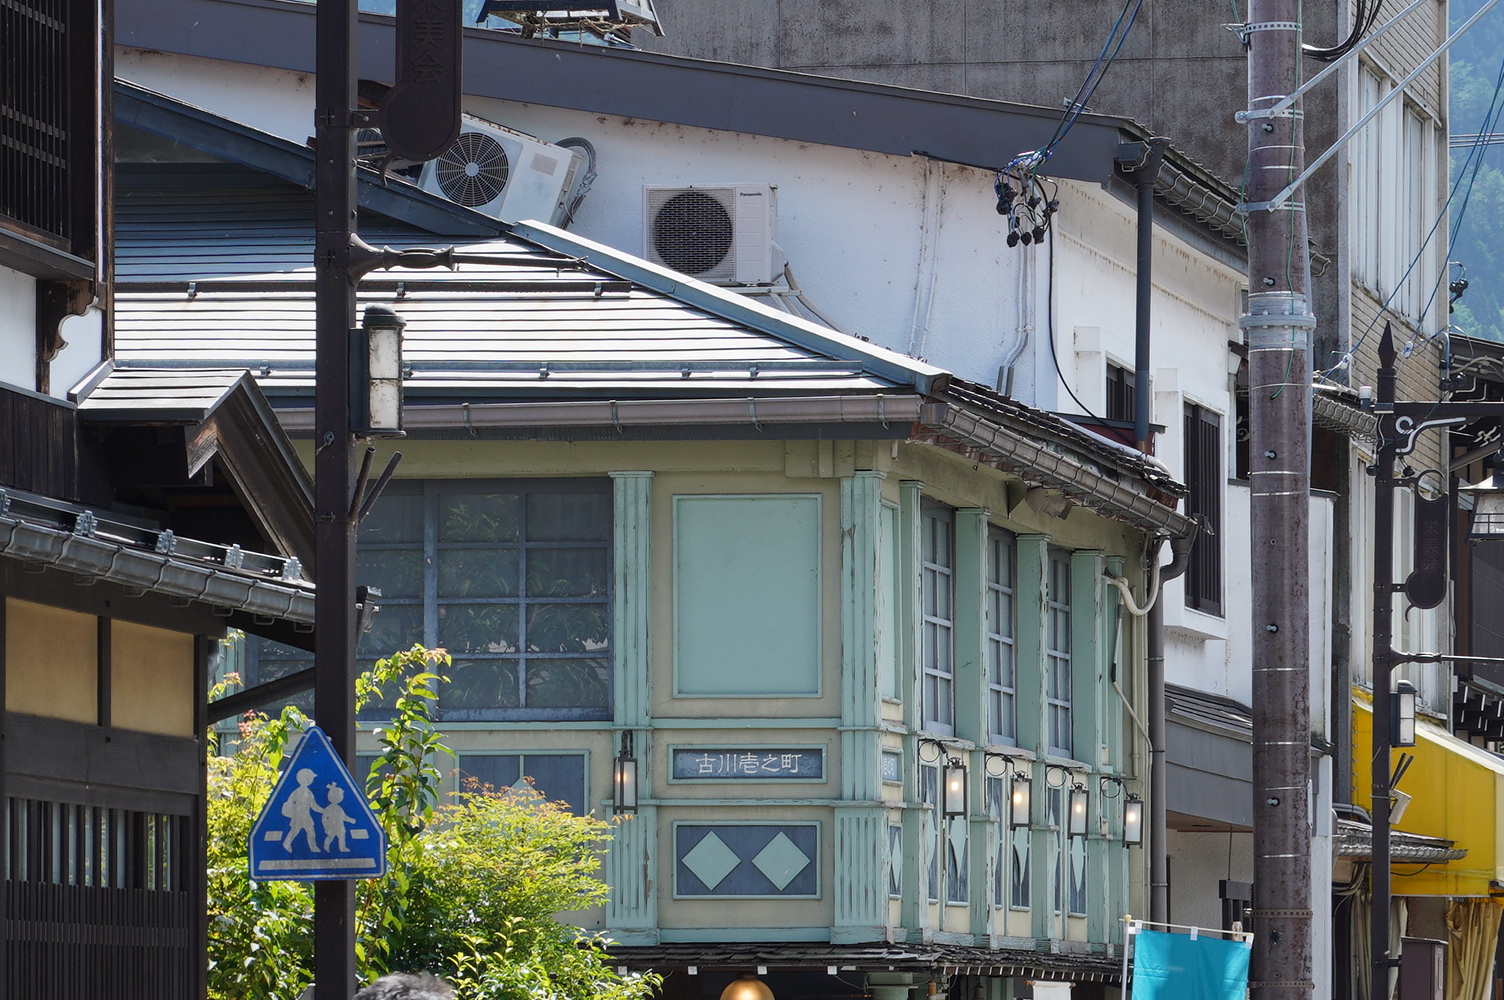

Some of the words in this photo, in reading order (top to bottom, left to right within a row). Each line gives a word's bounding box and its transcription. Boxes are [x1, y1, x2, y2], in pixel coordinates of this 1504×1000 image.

[695, 752, 802, 774] 古川壱之町
